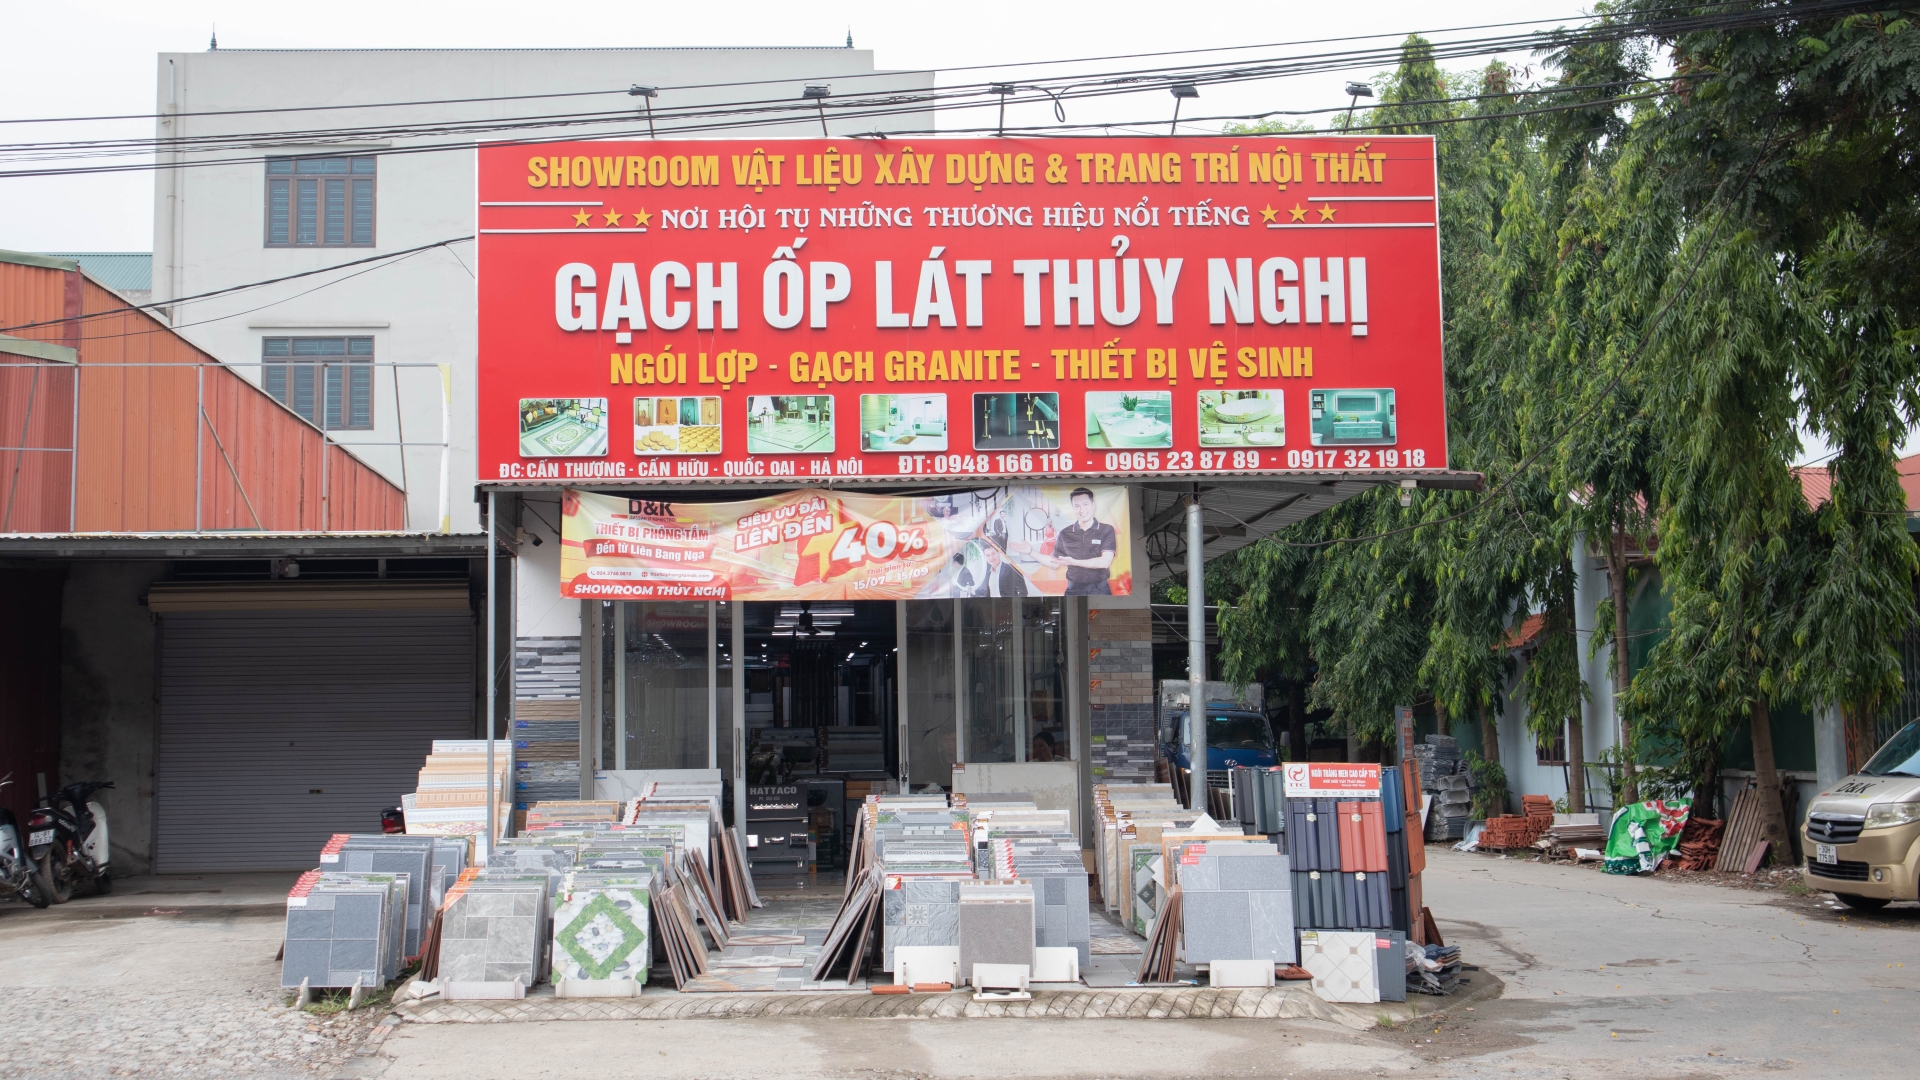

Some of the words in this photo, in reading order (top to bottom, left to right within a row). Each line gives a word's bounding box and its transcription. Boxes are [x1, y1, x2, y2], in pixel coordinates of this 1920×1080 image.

[527, 155, 720, 188] SHOWROOM
[732, 147, 785, 193] VẬT
[796, 146, 863, 192] LIỆU
[874, 146, 935, 184] XÂY
[945, 151, 1034, 192] DỰNG
[1044, 153, 1068, 184] &
[1076, 152, 1182, 183] TRANG
[1190, 145, 1240, 183] TRÍ
[1248, 146, 1303, 191] NỘI
[1311, 141, 1387, 183] THẤT
[661, 206, 709, 229] NƠI
[718, 204, 766, 234] HỘI
[774, 207, 810, 233] TỤ
[819, 201, 913, 228] NHỮNG
[922, 203, 1034, 227] THƯƠNG
[1042, 201, 1105, 232] HIỆU
[1113, 196, 1160, 227] NỔI
[1168, 198, 1251, 227] TIẾNG
[555, 260, 739, 345] GẠCH
[762, 237, 852, 329] ỐP
[875, 245, 992, 328] LÁT
[1012, 234, 1184, 328] THỦY
[1207, 257, 1368, 337] NGHỊ
[610, 345, 687, 385] NGÓI
[698, 349, 758, 390] LỢP
[789, 350, 875, 389] GẠCH
[885, 348, 1021, 382] GRANITE
[1050, 338, 1137, 381] THIẾT
[1146, 347, 1177, 386] BỊ
[1188, 341, 1228, 386] VỆ
[1237, 346, 1313, 379] SINH
[565, 460, 626, 479] THƯỢNG
[638, 457, 670, 477] CẤN
[677, 457, 709, 477] HỮU
[723, 456, 764, 476] QUỐC
[770, 460, 795, 476] OAI
[811, 457, 831, 475] HÀ
[837, 456, 863, 476] NỘI
[995, 454, 1033, 473] 166
[1039, 453, 1073, 472] 116
[1105, 452, 1160, 471] 0965
[1166, 452, 1194, 470] 23
[1200, 452, 1227, 469] 87
[1233, 451, 1260, 469] 89
[1287, 450, 1338, 469] 0917
[1344, 450, 1371, 468] 32
[1376, 450, 1399, 468] 19
[1402, 450, 1426, 468] 18
[628, 499, 675, 516] D&K
[738, 512, 772, 529] SIÊU
[774, 505, 796, 520] ƯU
[799, 497, 826, 515] ĐÃI
[594, 522, 626, 537] THIẾT
[627, 528, 640, 541] BỊ
[642, 525, 683, 540] PHÒNG
[736, 526, 778, 551] LÊN
[783, 512, 832, 540] ĐẾN
[831, 521, 925, 564] 40%
[595, 540, 615, 555] Đến
[617, 542, 628, 554] từ
[630, 544, 651, 557] Liên
[655, 548, 681, 562] Bang
[684, 549, 705, 562] Nga
[852, 575, 886, 591] 15/07
[896, 566, 929, 582] 15/09
[866, 566, 883, 576] Thời
[884, 564, 901, 574] gian
[573, 584, 653, 596] SHOWROOM
[656, 583, 693, 597] THỦY
[693, 586, 726, 598] NGHỊ
[749, 786, 797, 795] HATTACO
[1835, 782, 1877, 794] D&K
